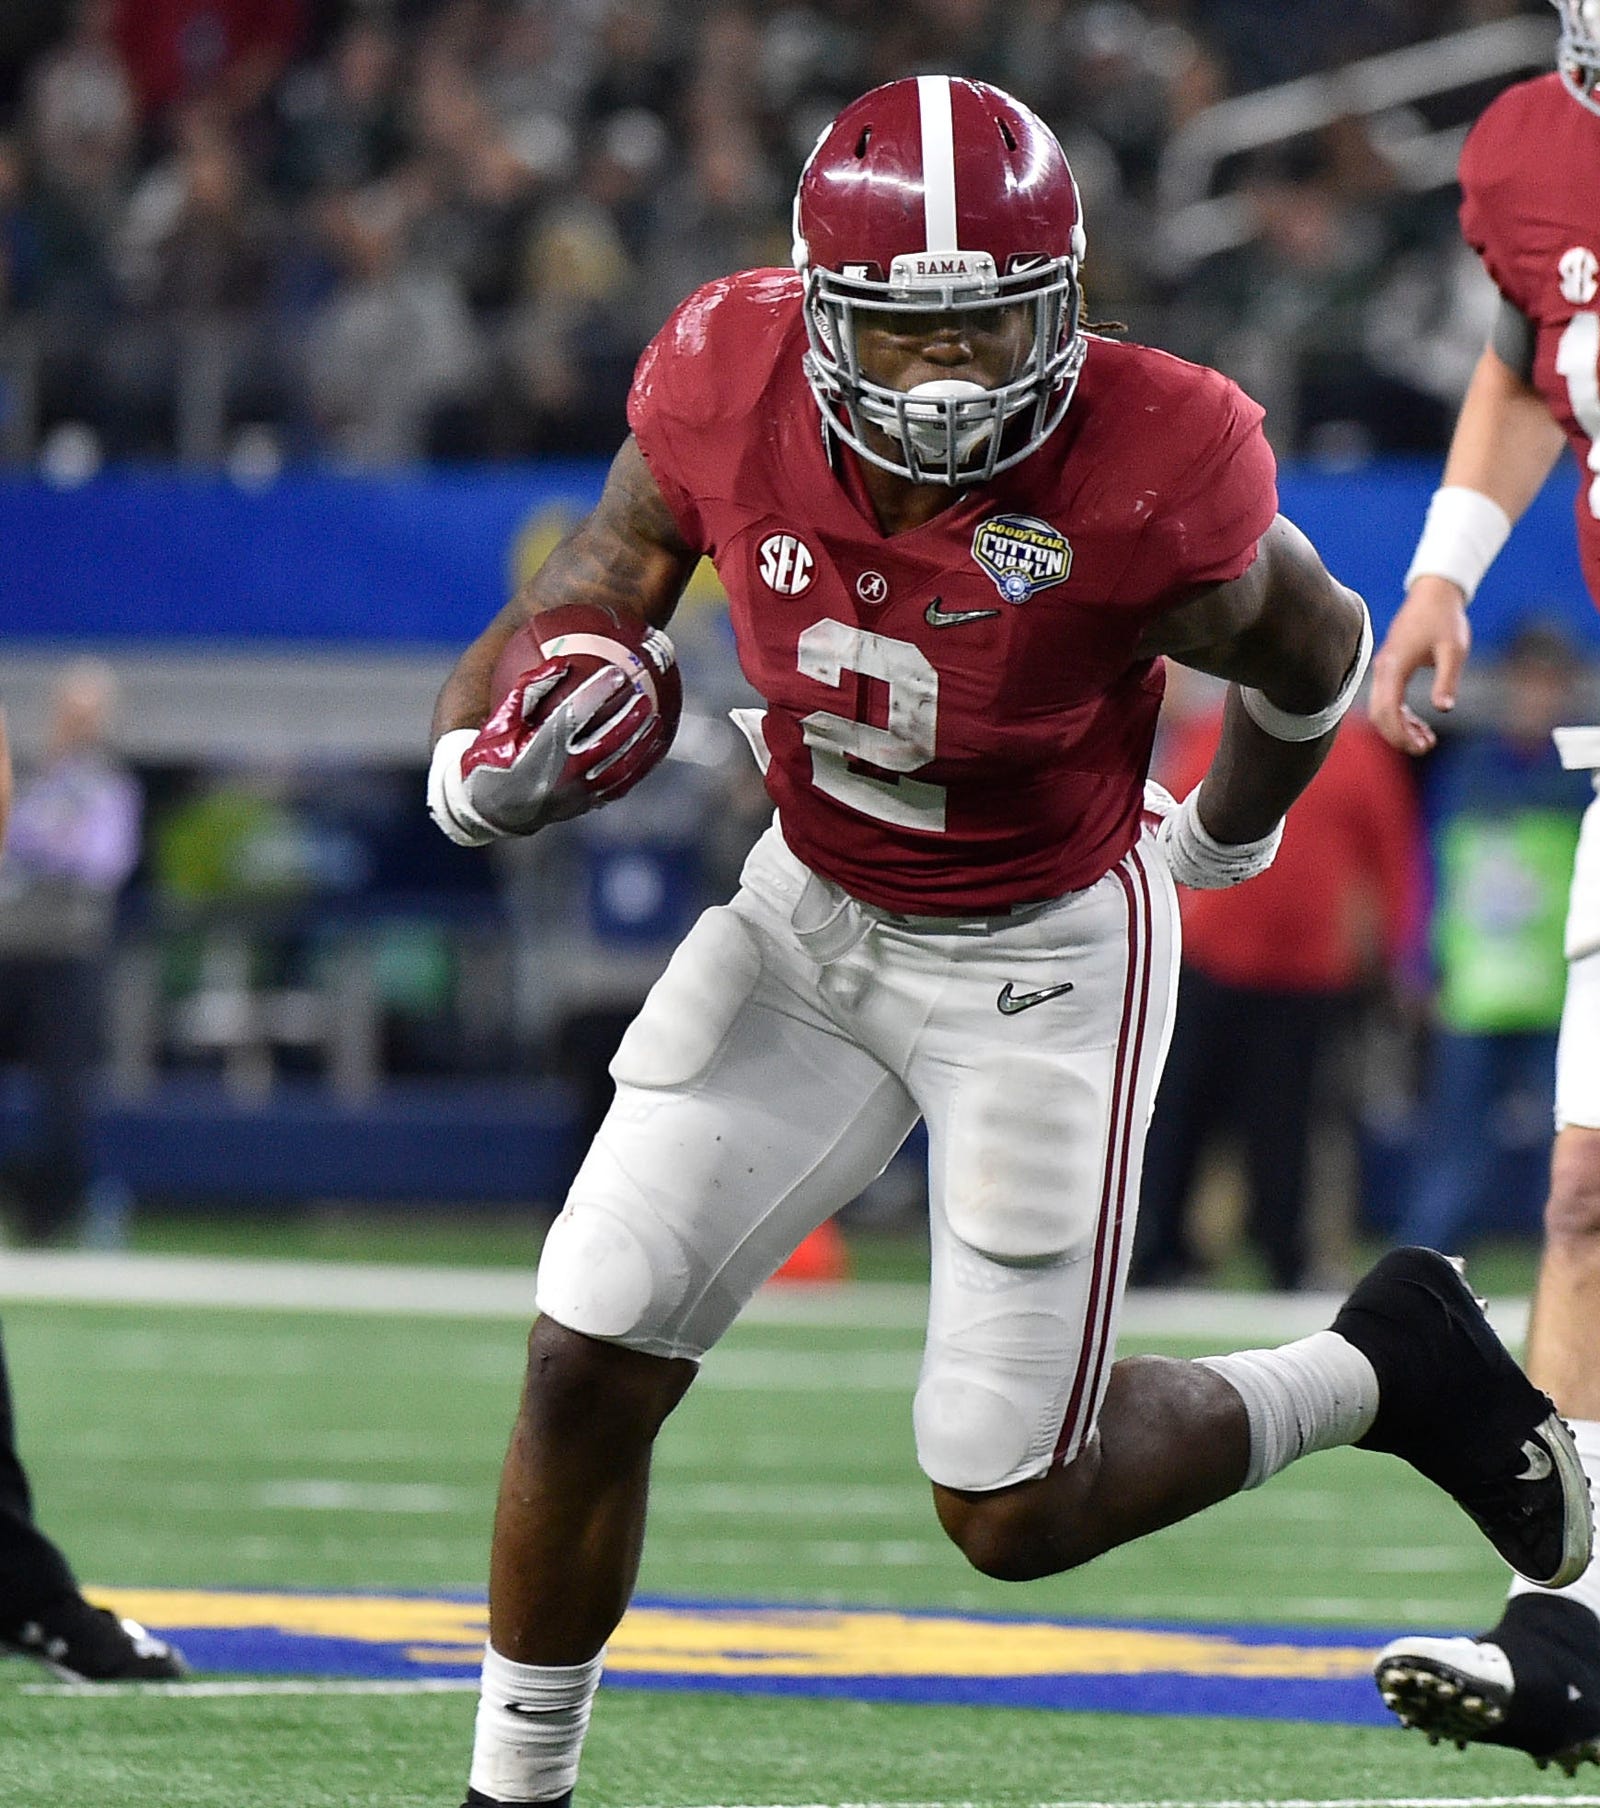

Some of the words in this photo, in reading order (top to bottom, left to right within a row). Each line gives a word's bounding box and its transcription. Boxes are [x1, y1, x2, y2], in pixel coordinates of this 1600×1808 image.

[917, 260, 968, 275] BAMA
[986, 522, 1064, 549] GOODYEAR
[759, 535, 814, 595] SEC
[981, 534, 1063, 575] COTTON
[993, 552, 1045, 577] BOWL
[797, 617, 946, 833] 2
